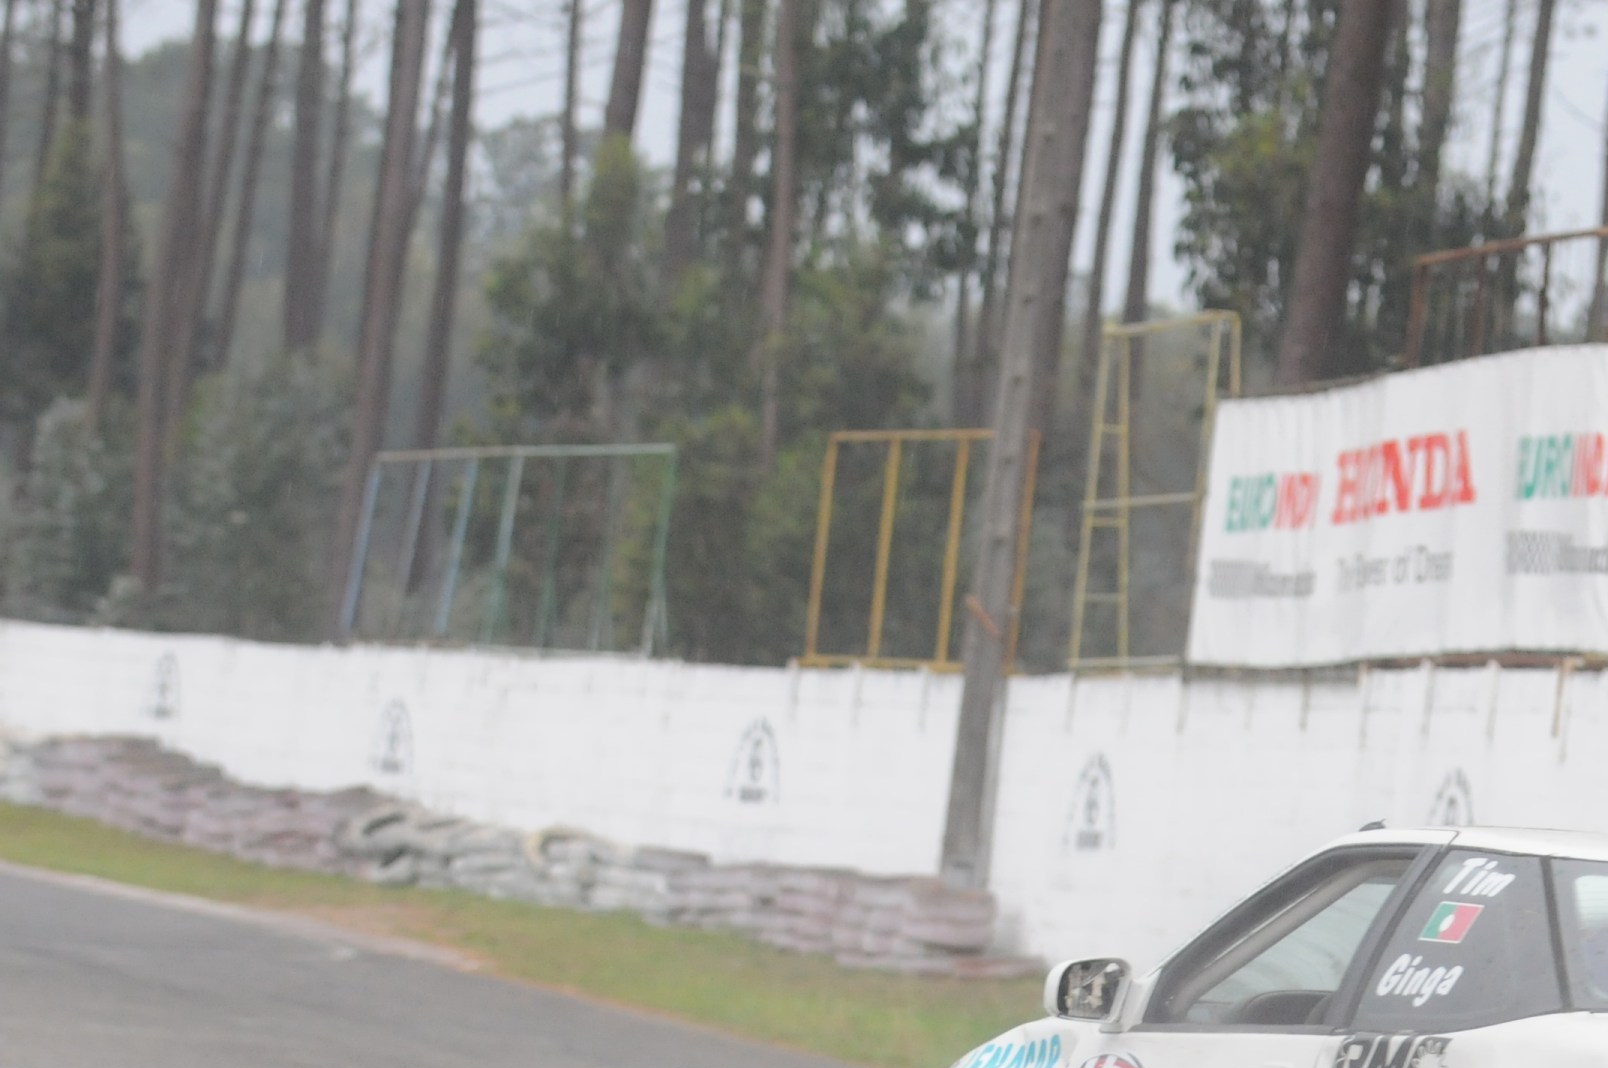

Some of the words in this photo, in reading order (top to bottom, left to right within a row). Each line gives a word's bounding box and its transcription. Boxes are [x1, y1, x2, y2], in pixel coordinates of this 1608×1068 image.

[1330, 428, 1475, 525] HONDA
[1442, 857, 1516, 898] Tim
[1376, 953, 1464, 1008] Ginga
